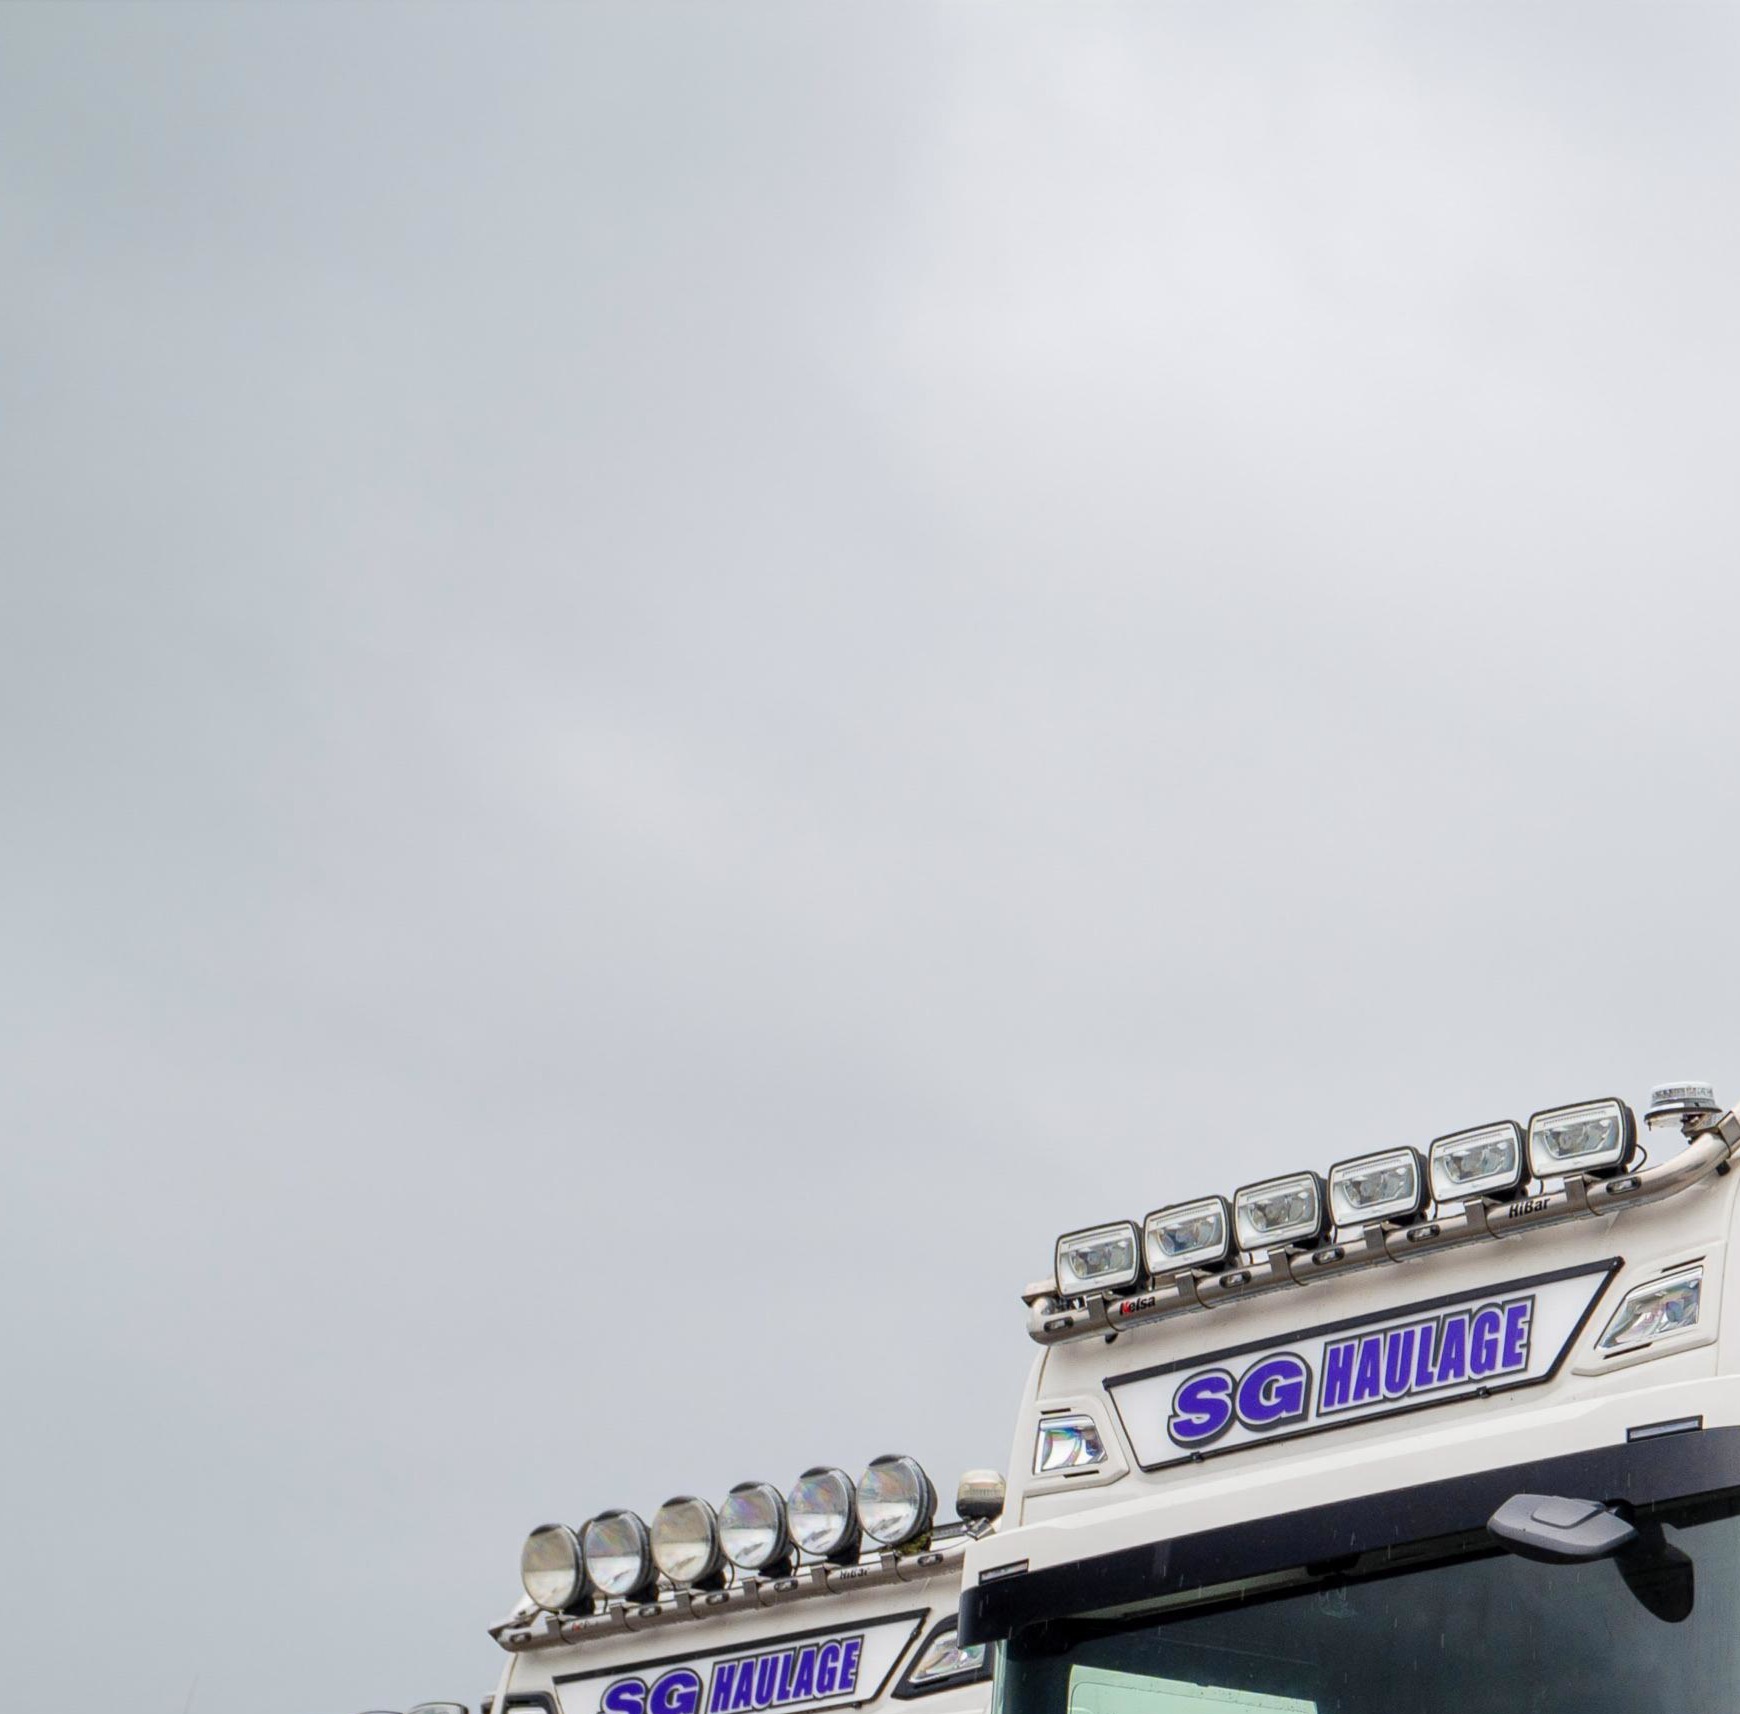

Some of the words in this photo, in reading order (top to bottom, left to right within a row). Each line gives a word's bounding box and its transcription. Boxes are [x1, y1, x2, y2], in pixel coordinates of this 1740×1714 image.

[1509, 1198, 1550, 1218] HiBar
[1119, 1296, 1155, 1315] Kelsa
[1168, 1351, 1312, 1447] SG
[1319, 1296, 1534, 1414] HAULAGE
